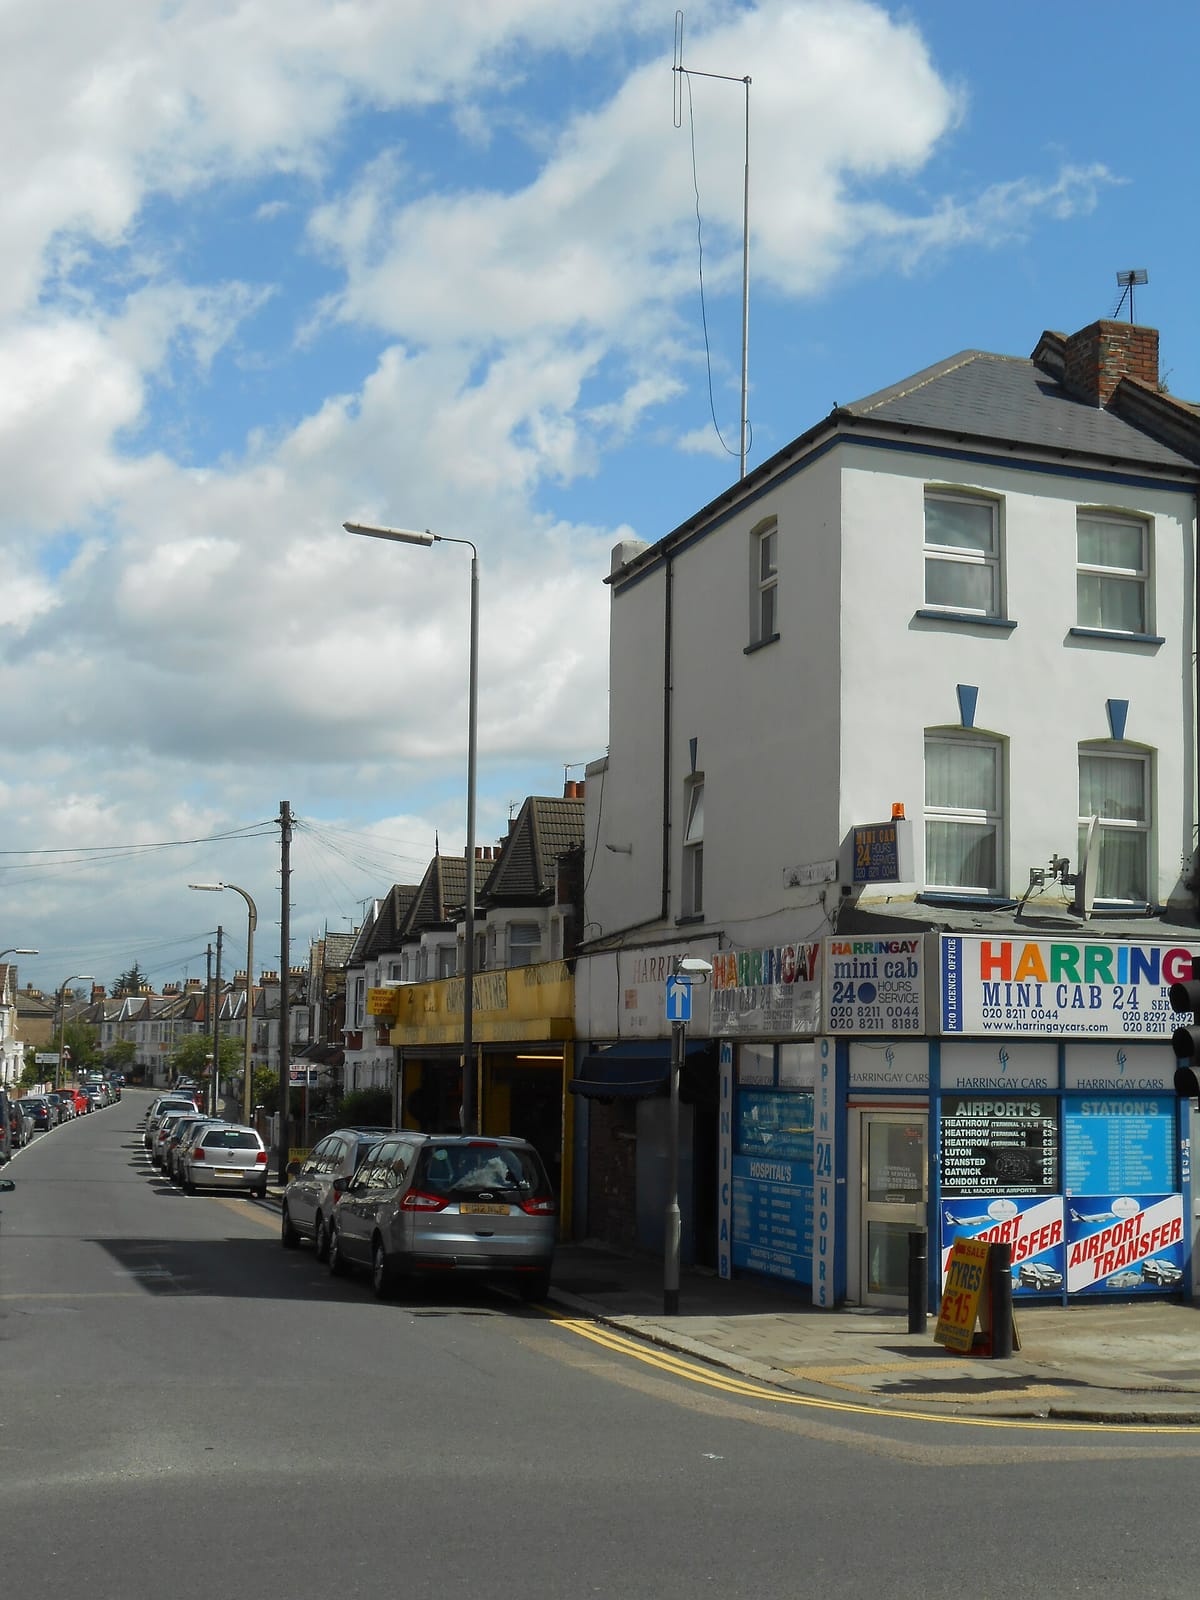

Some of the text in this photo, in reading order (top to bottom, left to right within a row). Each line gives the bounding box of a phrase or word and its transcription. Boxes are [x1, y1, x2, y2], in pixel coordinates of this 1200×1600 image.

[857, 844, 871, 867] 24
[831, 940, 919, 955] HARRINGAY
[712, 943, 820, 990] HARRINGAY
[834, 957, 919, 979] mini cab
[947, 938, 957, 1030] PCO LICENCE OFFICE
[832, 981, 912, 1004] 24 HOURS
[878, 992, 919, 1004] SERVICE
[982, 982, 1139, 1011] MINI CAB 24
[830, 1006, 919, 1017] 020 8211 0044
[982, 1009, 1059, 1020] 020 8211 0044
[1122, 1011, 1193, 1023] 020 8292 4392
[830, 1018, 919, 1029] 020 8211 8188
[982, 1020, 1109, 1033] www.harringaycars.com
[1123, 1022, 1142, 1032] 020
[1145, 1023, 1166, 1033] 8211
[848, 1072, 930, 1083] HARRINGAY CARS
[956, 1077, 1048, 1089] HARRINGAY CARS
[1077, 1079, 1164, 1089] HARRINGAY CARS
[956, 1101, 1041, 1117] AIRPORT'S
[1081, 1102, 1158, 1116] STATION'S
[944, 1119, 990, 1128] HEATHROW
[944, 1129, 990, 1137] HEATHROW
[944, 1139, 990, 1147] HEATHROW
[944, 1148, 972, 1156] LUTON
[817, 1142, 832, 1178] 24
[944, 1158, 986, 1166] STANSTED
[750, 1161, 792, 1182] HOSPITAL'S
[944, 1168, 981, 1176] GATWICK
[944, 1177, 999, 1185] LONDON CITY
[1069, 1212, 1145, 1269] AIRPORT
[966, 1246, 986, 1259] SALE
[1093, 1217, 1182, 1280] TRANSFER
[948, 1261, 982, 1292] TYRES
[941, 1293, 972, 1325] £15
